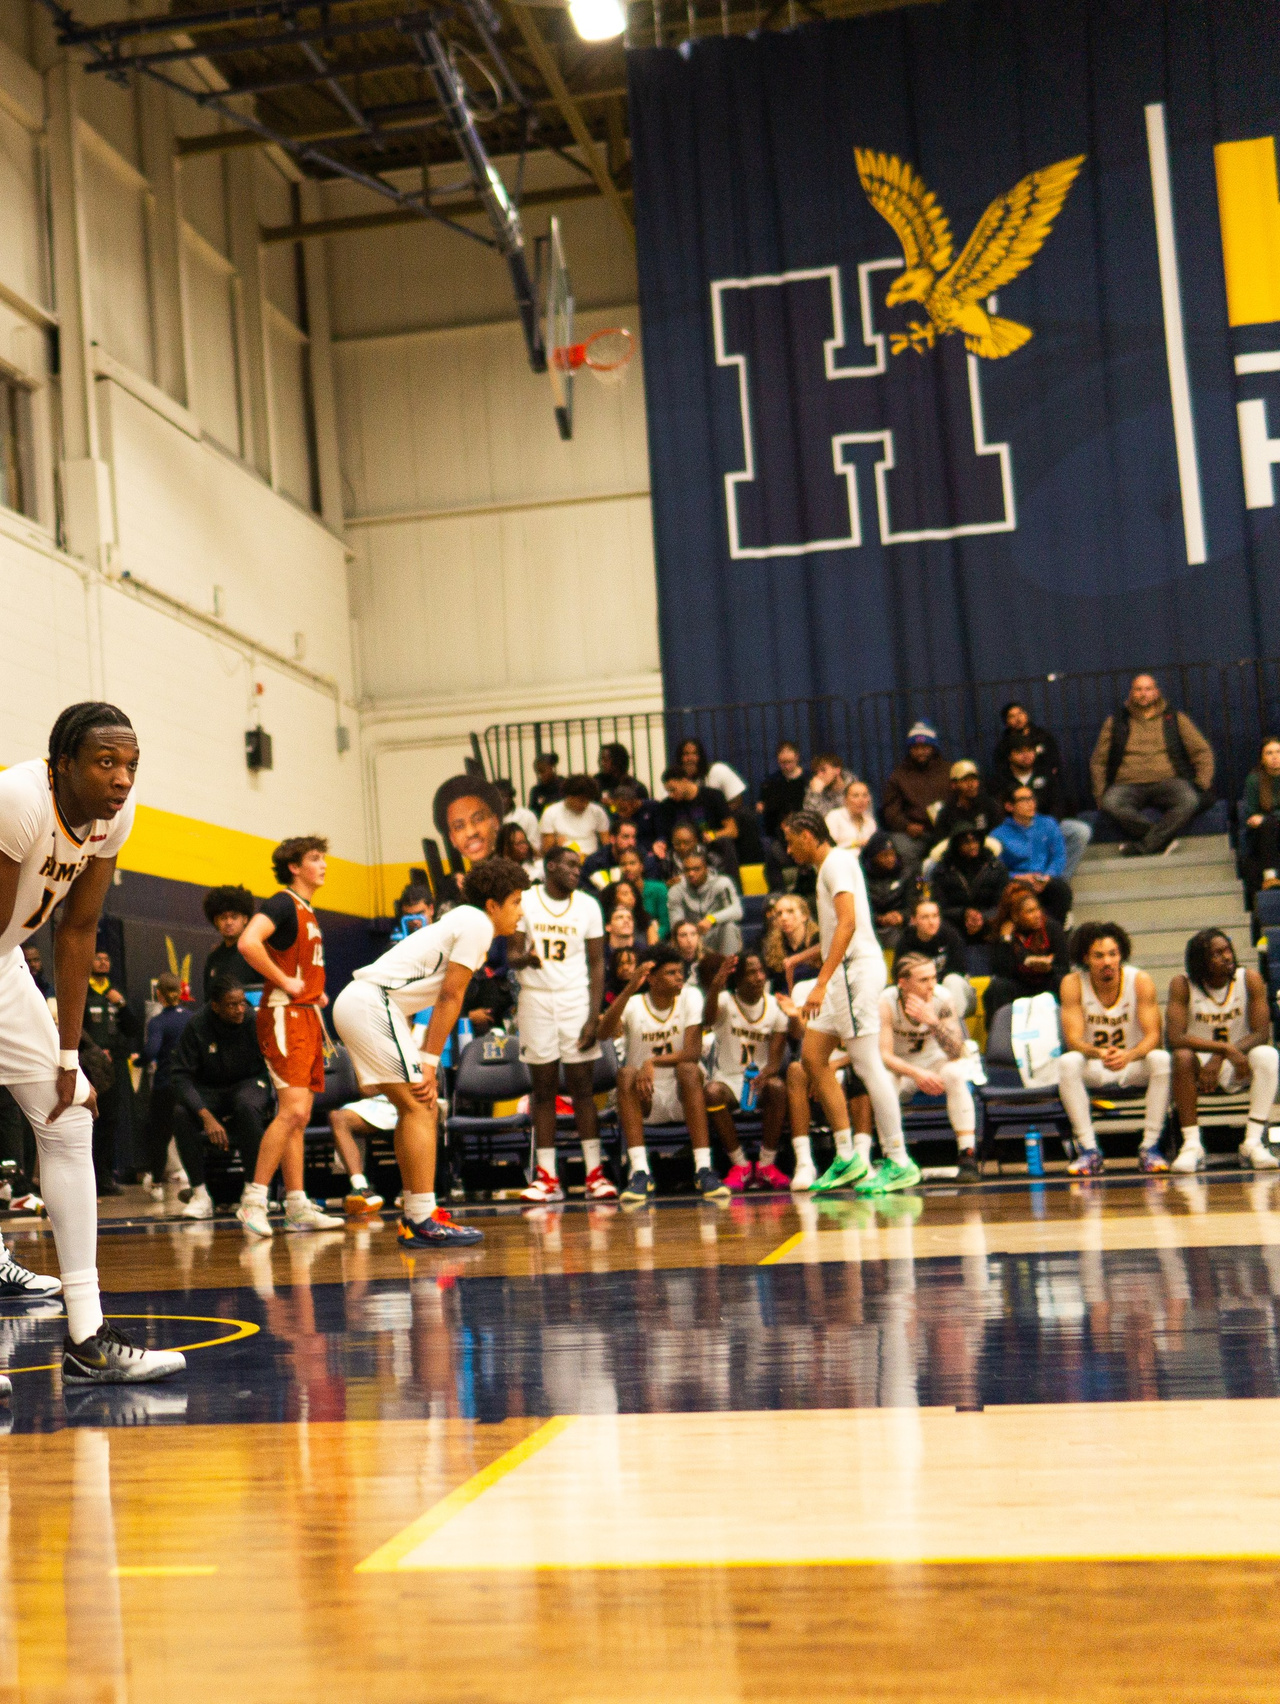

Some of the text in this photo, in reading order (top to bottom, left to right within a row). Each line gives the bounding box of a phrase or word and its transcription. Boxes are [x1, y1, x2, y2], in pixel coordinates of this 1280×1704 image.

[534, 923, 577, 936] HUMBER
[542, 938, 567, 962] 13
[1093, 1029, 1126, 1049] 22
